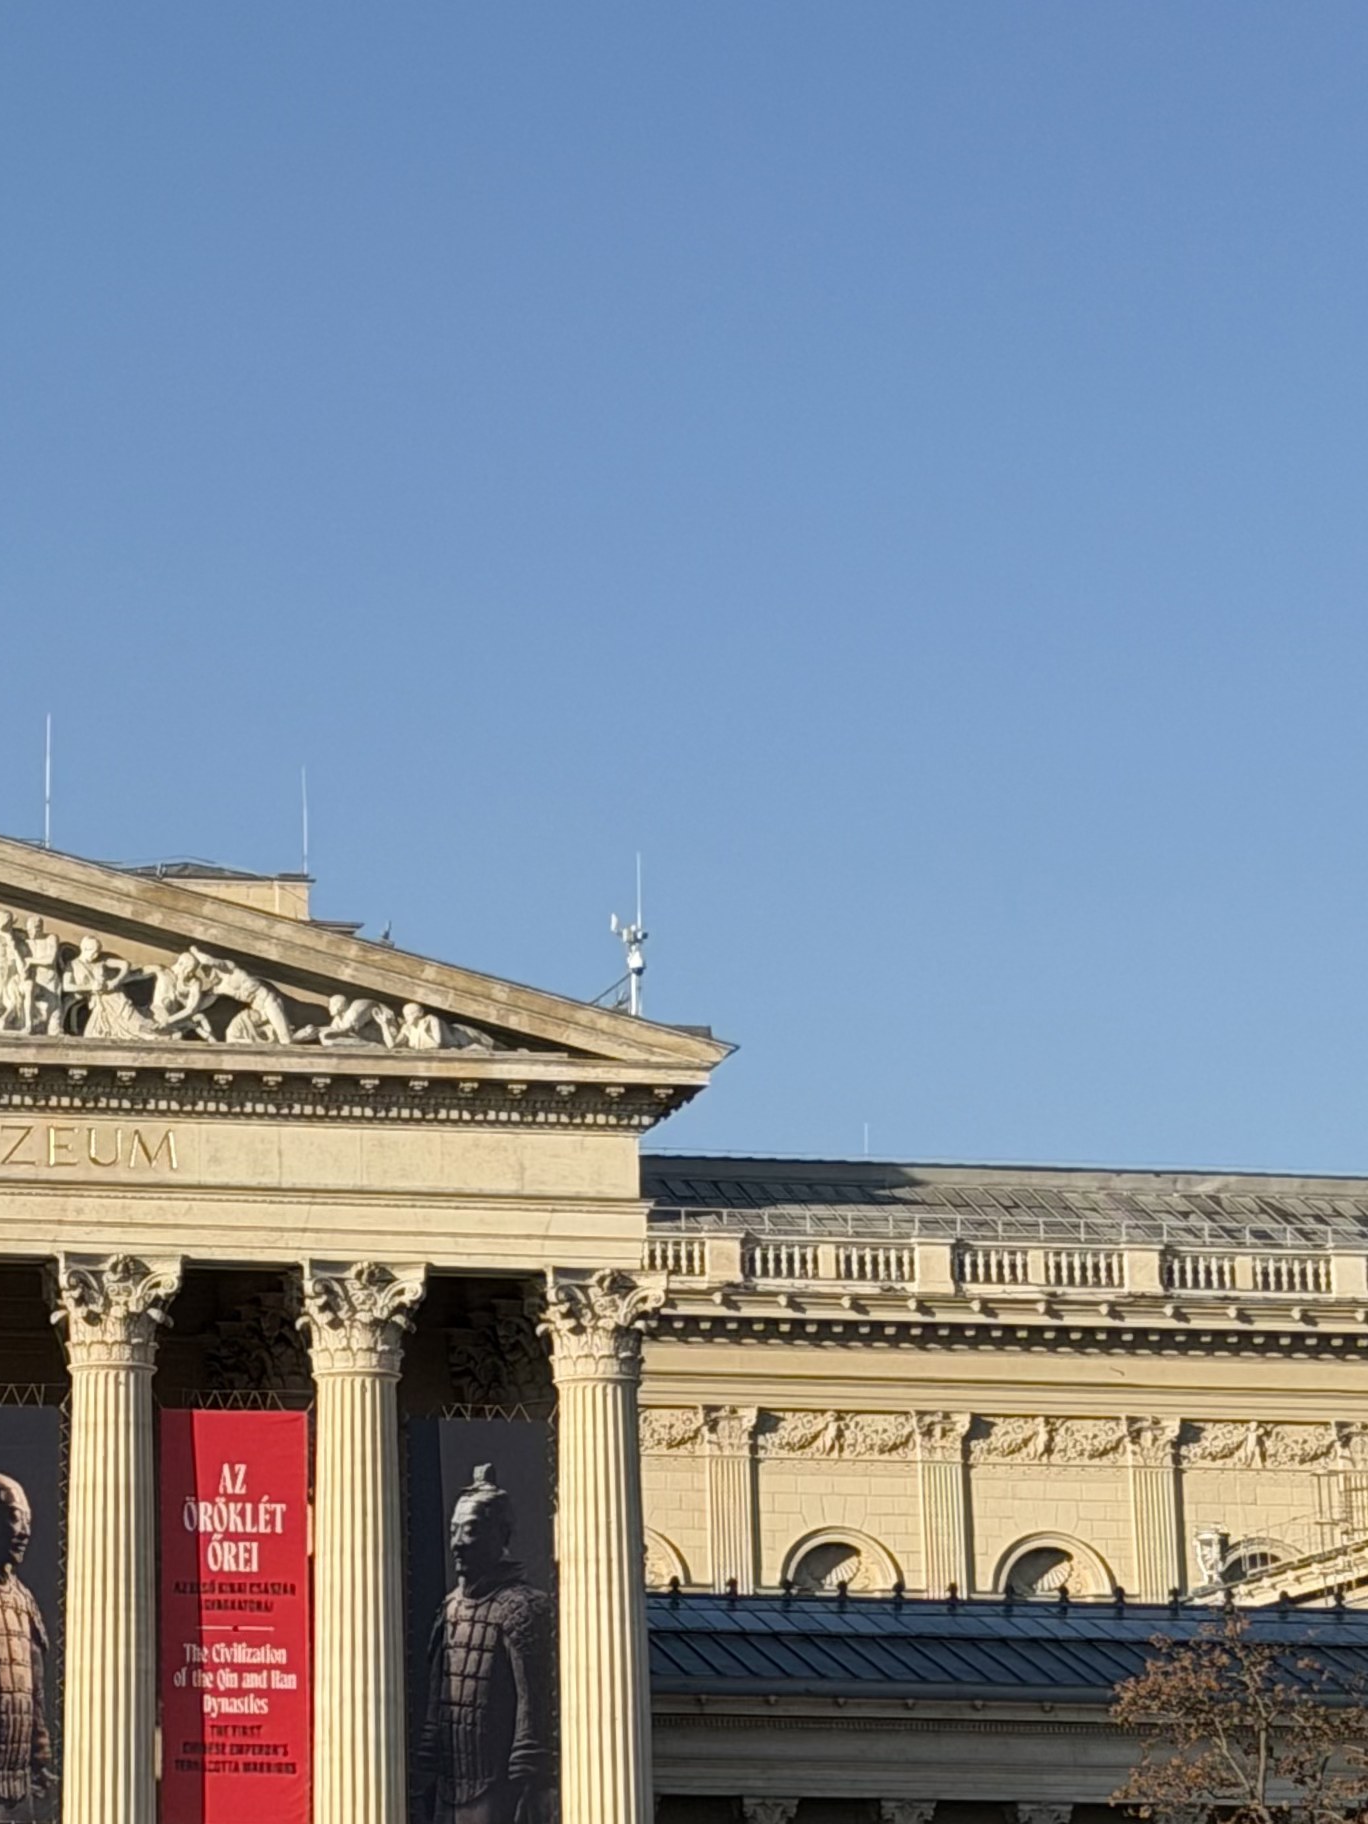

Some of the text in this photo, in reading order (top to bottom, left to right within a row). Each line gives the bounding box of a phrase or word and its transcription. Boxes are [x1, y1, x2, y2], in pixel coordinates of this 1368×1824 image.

[218, 1462, 247, 1495] AZ
[183, 1494, 287, 1534] ÖRÖKLÉT
[207, 1533, 259, 1573] ŐREI
[183, 1641, 288, 1665] The Civilization
[173, 1665, 297, 1692] of the Qin and Han
[203, 1692, 269, 1719] Dynasties
